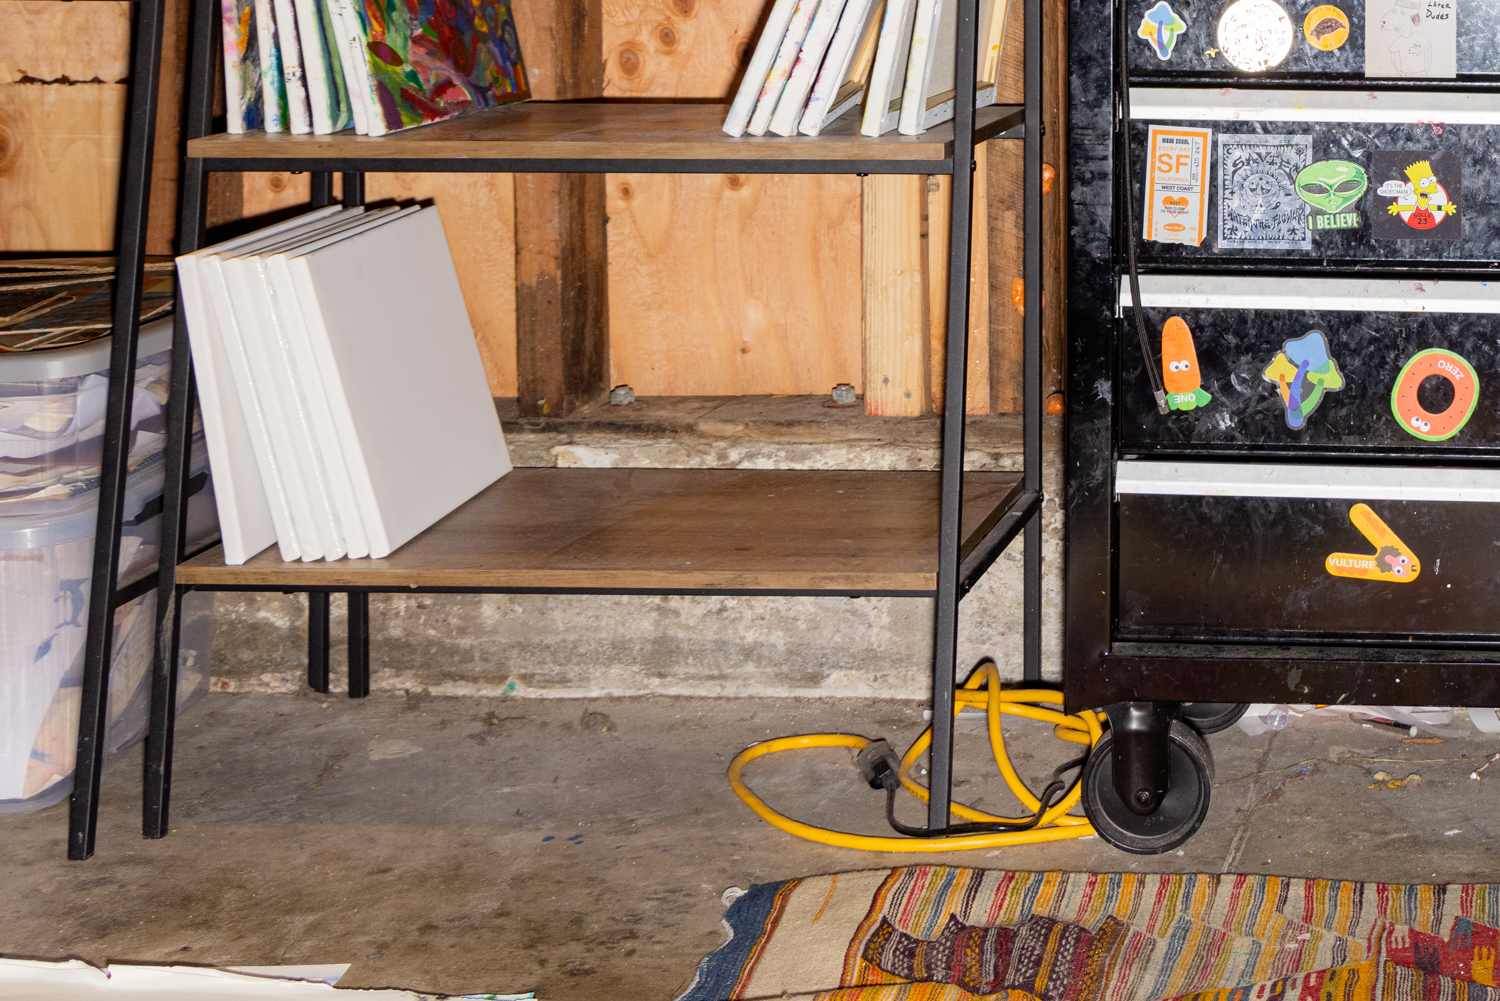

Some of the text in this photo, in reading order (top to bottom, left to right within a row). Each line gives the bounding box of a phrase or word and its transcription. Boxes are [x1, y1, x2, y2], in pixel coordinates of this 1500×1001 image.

[1426, 9, 1450, 20] Dudes
[1157, 154, 1190, 174] SF
[1437, 358, 1466, 381] ZERO
[1174, 392, 1196, 404] ONE
[1328, 556, 1376, 570] VULTURE
